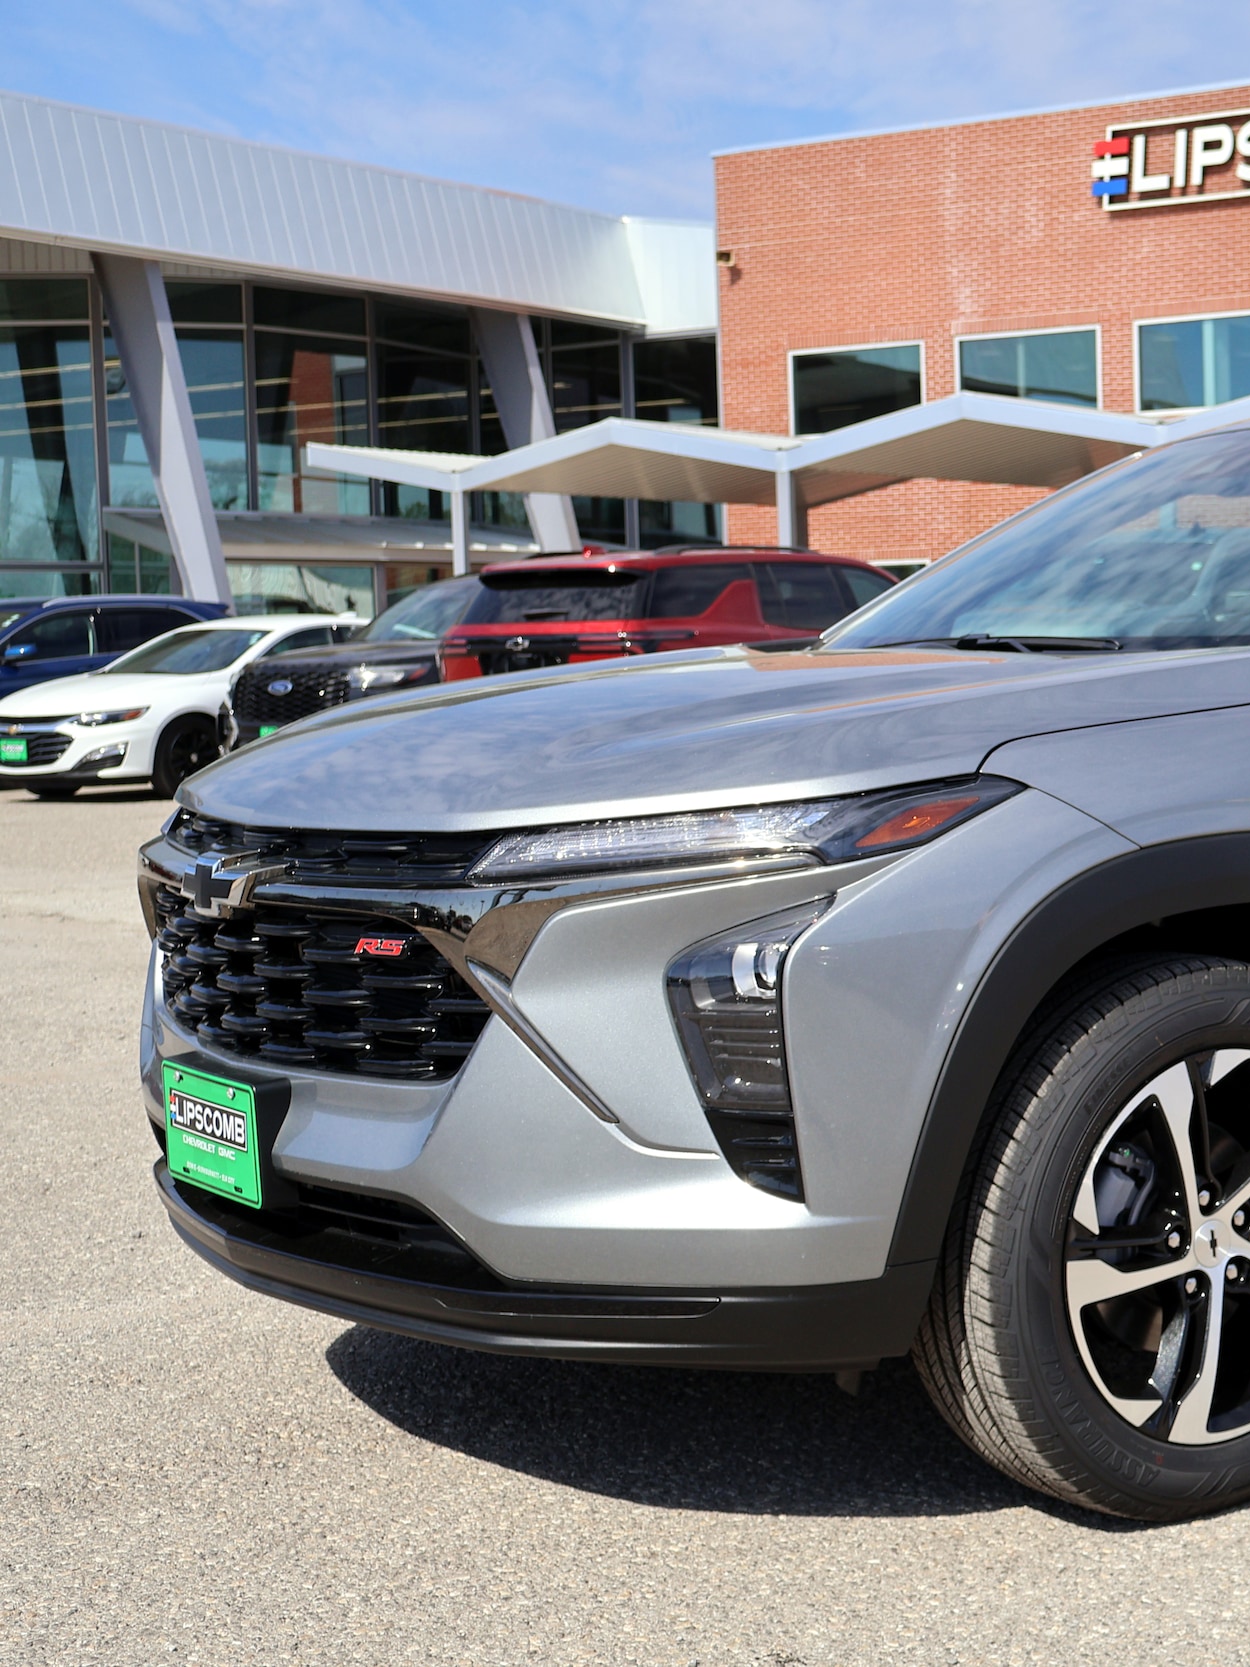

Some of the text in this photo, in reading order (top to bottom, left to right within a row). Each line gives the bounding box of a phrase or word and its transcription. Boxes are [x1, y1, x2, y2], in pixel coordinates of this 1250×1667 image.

[354, 937, 405, 956] RS
[175, 1097, 246, 1144] LIPSCOMB
[182, 1133, 236, 1161] CHEVROLET GMC
